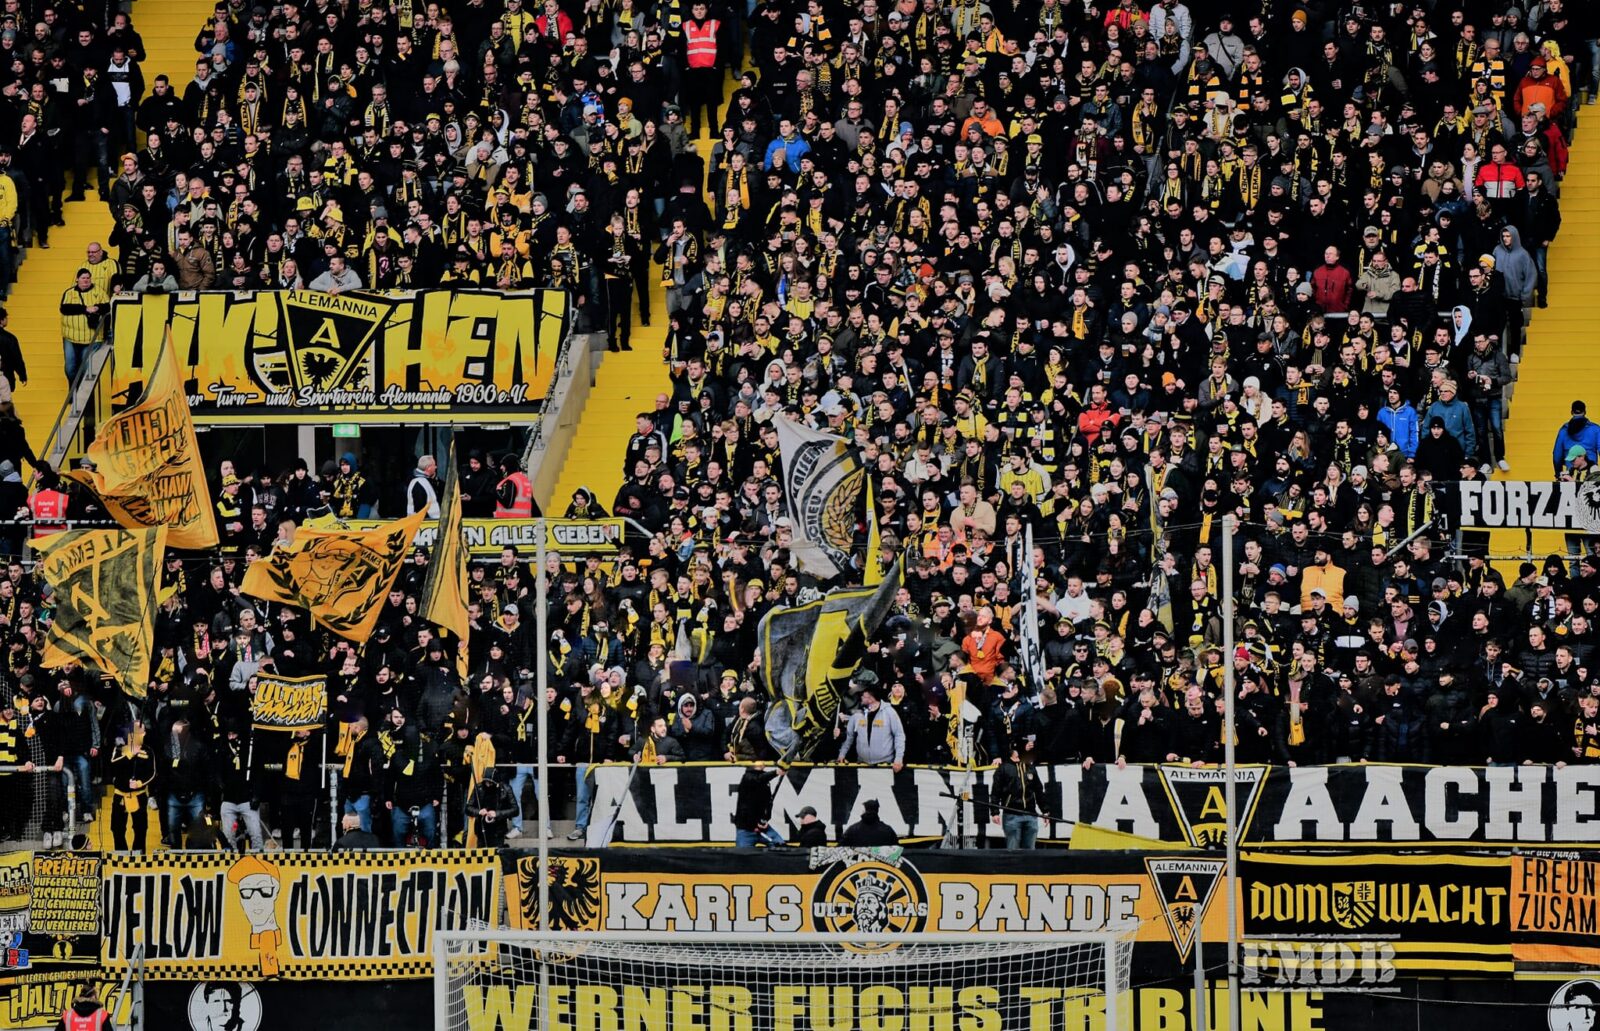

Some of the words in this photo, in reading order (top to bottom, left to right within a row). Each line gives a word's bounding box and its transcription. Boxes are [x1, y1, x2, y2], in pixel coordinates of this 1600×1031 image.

[287, 290, 378, 318] ALEMANNIA
[309, 317, 341, 349] A
[208, 383, 258, 408] Turn-
[265, 390, 291, 407] und
[296, 384, 376, 409] Sportverein
[379, 383, 451, 405] Alemannia
[455, 383, 497, 404] 1900
[1459, 480, 1582, 528] FORZA
[34, 858, 98, 876] FREIHEIT
[1154, 862, 1219, 873] ALEMANNIA
[1522, 857, 1596, 897] FREUN
[33, 888, 97, 899] SICHERHEIT
[34, 877, 80, 888] AUFGEBEN,
[83, 878, 97, 887] UM
[1174, 875, 1198, 900] A
[31, 899, 45, 909] ZU
[47, 899, 97, 910] GEWINNEN,
[31, 909, 61, 920] HEISST
[64, 910, 97, 920] BEIDES
[103, 874, 225, 960] YELLOW
[288, 869, 494, 958] CONNECTION
[605, 882, 803, 933] KARLS
[938, 881, 1142, 932] BANDE
[1379, 882, 1507, 927] WACHT
[1517, 893, 1597, 934] ZUSAM
[31, 920, 44, 930] ZU
[46, 921, 96, 931] VERLIEREN
[463, 984, 752, 1031] WERNER
[773, 983, 1002, 1031] FUCHS
